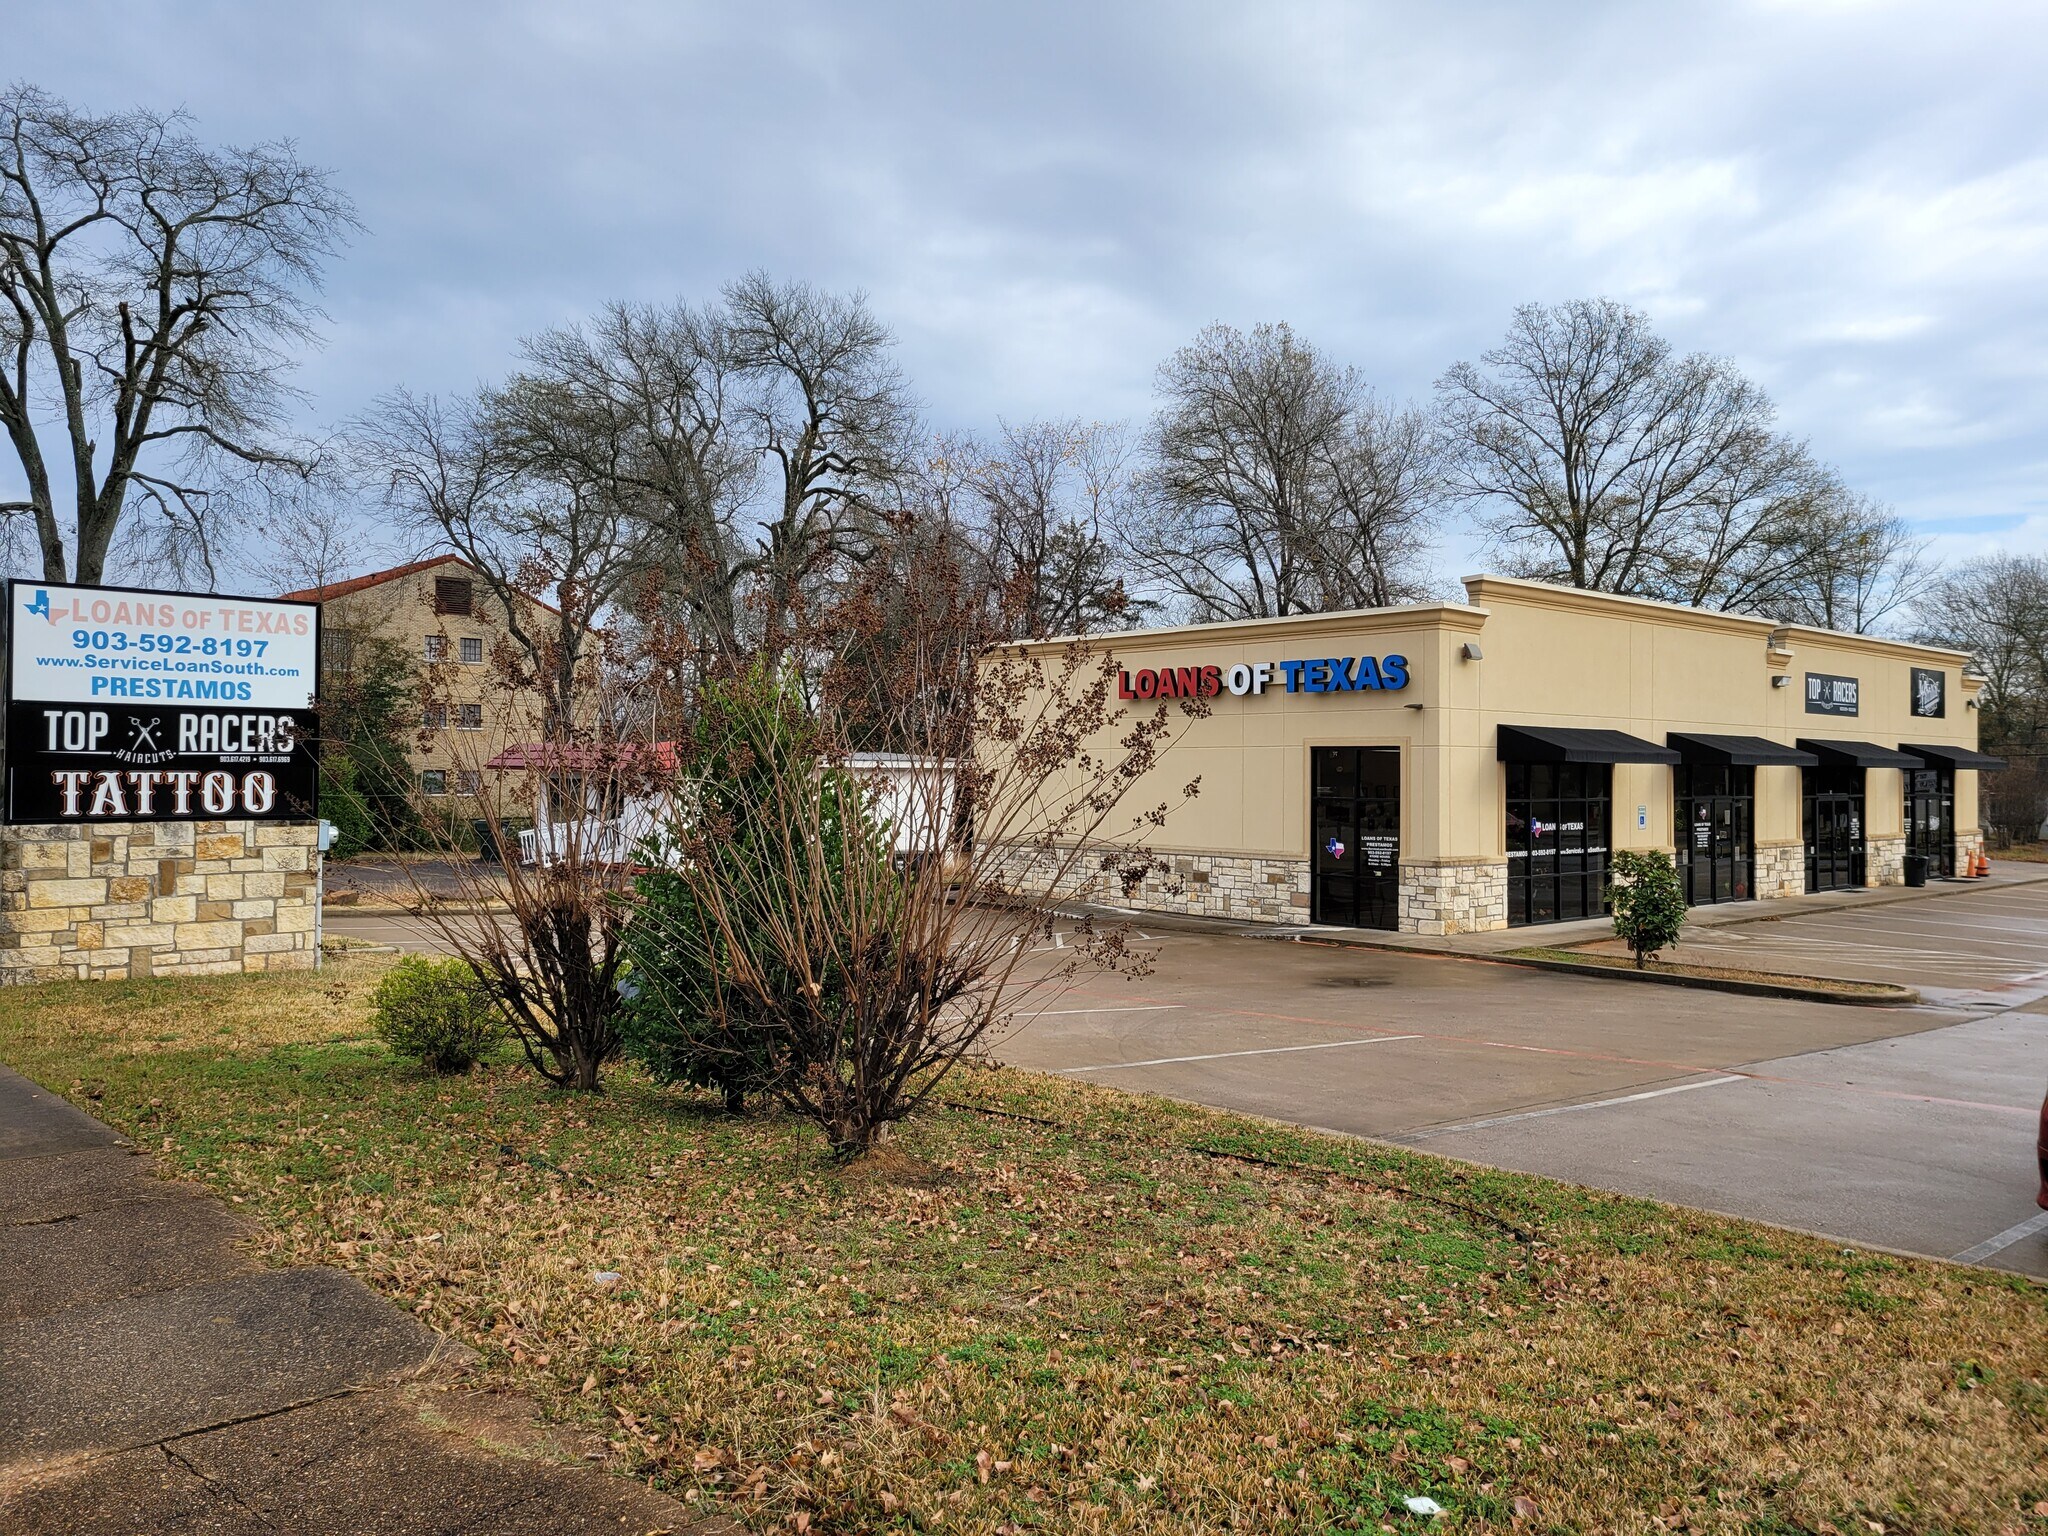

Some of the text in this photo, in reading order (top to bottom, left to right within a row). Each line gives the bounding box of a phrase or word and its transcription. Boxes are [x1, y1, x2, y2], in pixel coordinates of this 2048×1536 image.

[72, 598, 309, 636] LOANS OF TEXAS
[72, 629, 269, 658] 903-592-8197
[36, 654, 300, 677] www.ServiceLoanSouth.com
[1118, 654, 1411, 699] LOANS OF TEXAS
[91, 676, 252, 700] PRESTAMOS
[1808, 678, 1857, 703] TOP RACERS
[43, 710, 295, 752] TOP RACERS
[115, 748, 174, 763] HAIRCUTS
[52, 770, 277, 816] TATTOO
[1567, 822, 1584, 831] TEXAS
